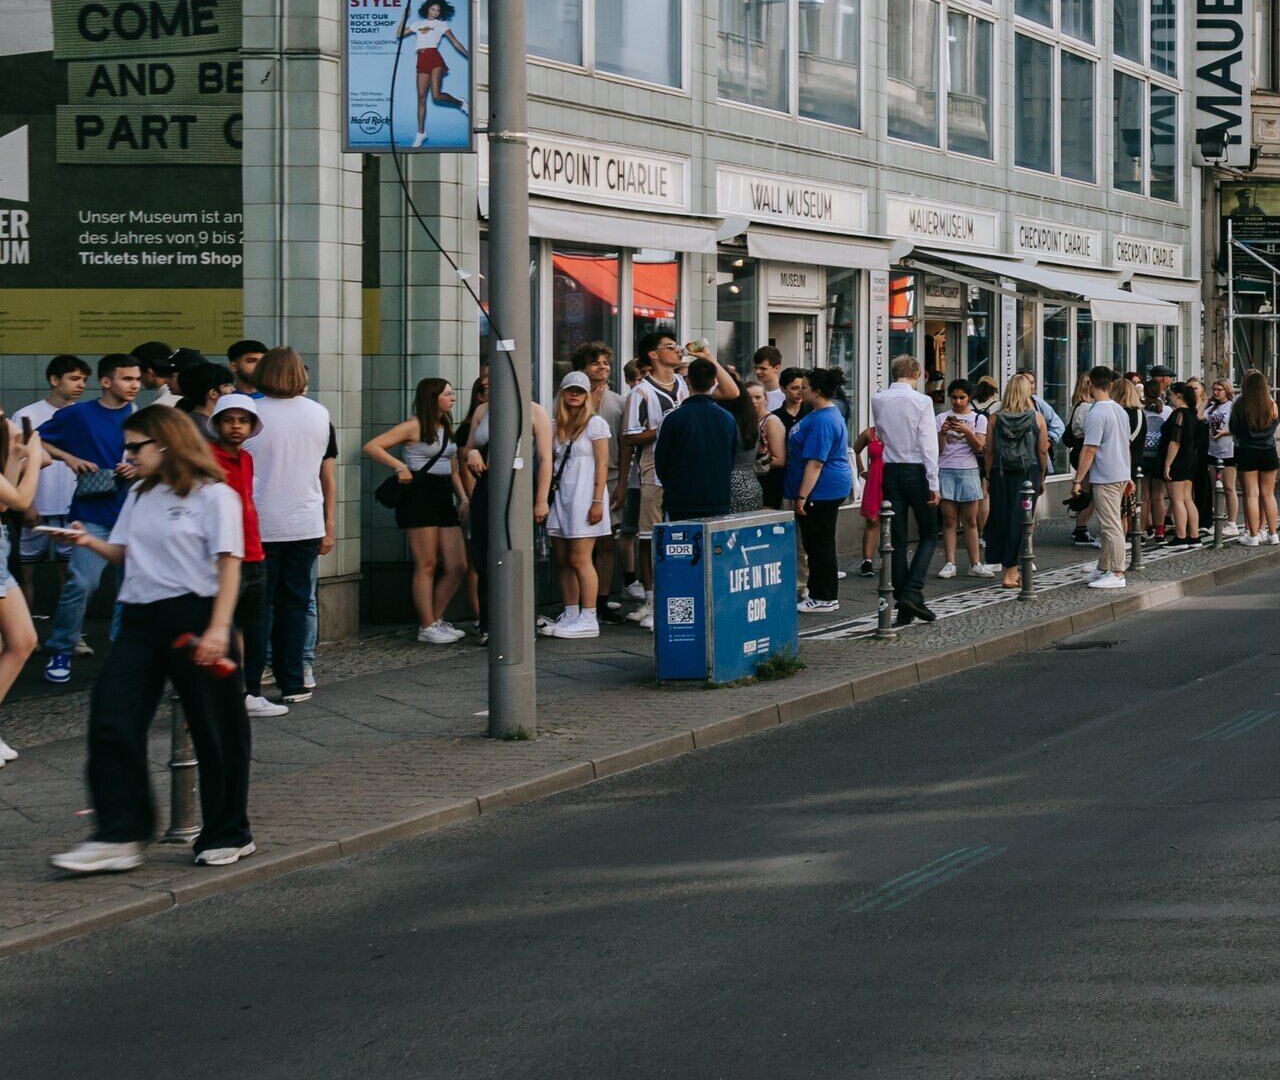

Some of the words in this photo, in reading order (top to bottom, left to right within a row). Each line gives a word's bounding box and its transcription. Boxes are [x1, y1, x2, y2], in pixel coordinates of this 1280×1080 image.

[86, 62, 175, 97] AND
[198, 61, 243, 95] BE
[75, 114, 198, 150] PART
[350, 115, 371, 125] Hard
[606, 158, 668, 198] CHARLIE
[750, 182, 783, 214] WALL
[786, 187, 833, 221] MUSEUM
[79, 210, 125, 224] Unser
[130, 210, 198, 224] Museum
[201, 210, 220, 224] ist
[908, 207, 975, 241] MAUERMUSEUM
[79, 230, 107, 244] des
[111, 230, 163, 244] Jahres
[165, 232, 195, 244] von
[198, 230, 209, 244] 9
[212, 230, 236, 244] bis
[1019, 225, 1063, 253] CHECKPOINT
[1063, 232, 1091, 258] CHARLIE
[79, 251, 138, 265] Tickets
[142, 251, 174, 265] hier
[177, 251, 197, 265] im
[201, 251, 243, 268] Shop
[1116, 241, 1151, 265] CHECKPOINT
[1152, 247, 1174, 269] CHARLIE
[780, 272, 806, 288] MUSEUM
[668, 546, 691, 554] DDR
[729, 566, 750, 593] LIFE
[752, 565, 763, 589] IN
[764, 561, 782, 586] THE
[747, 597, 767, 622] GDR
